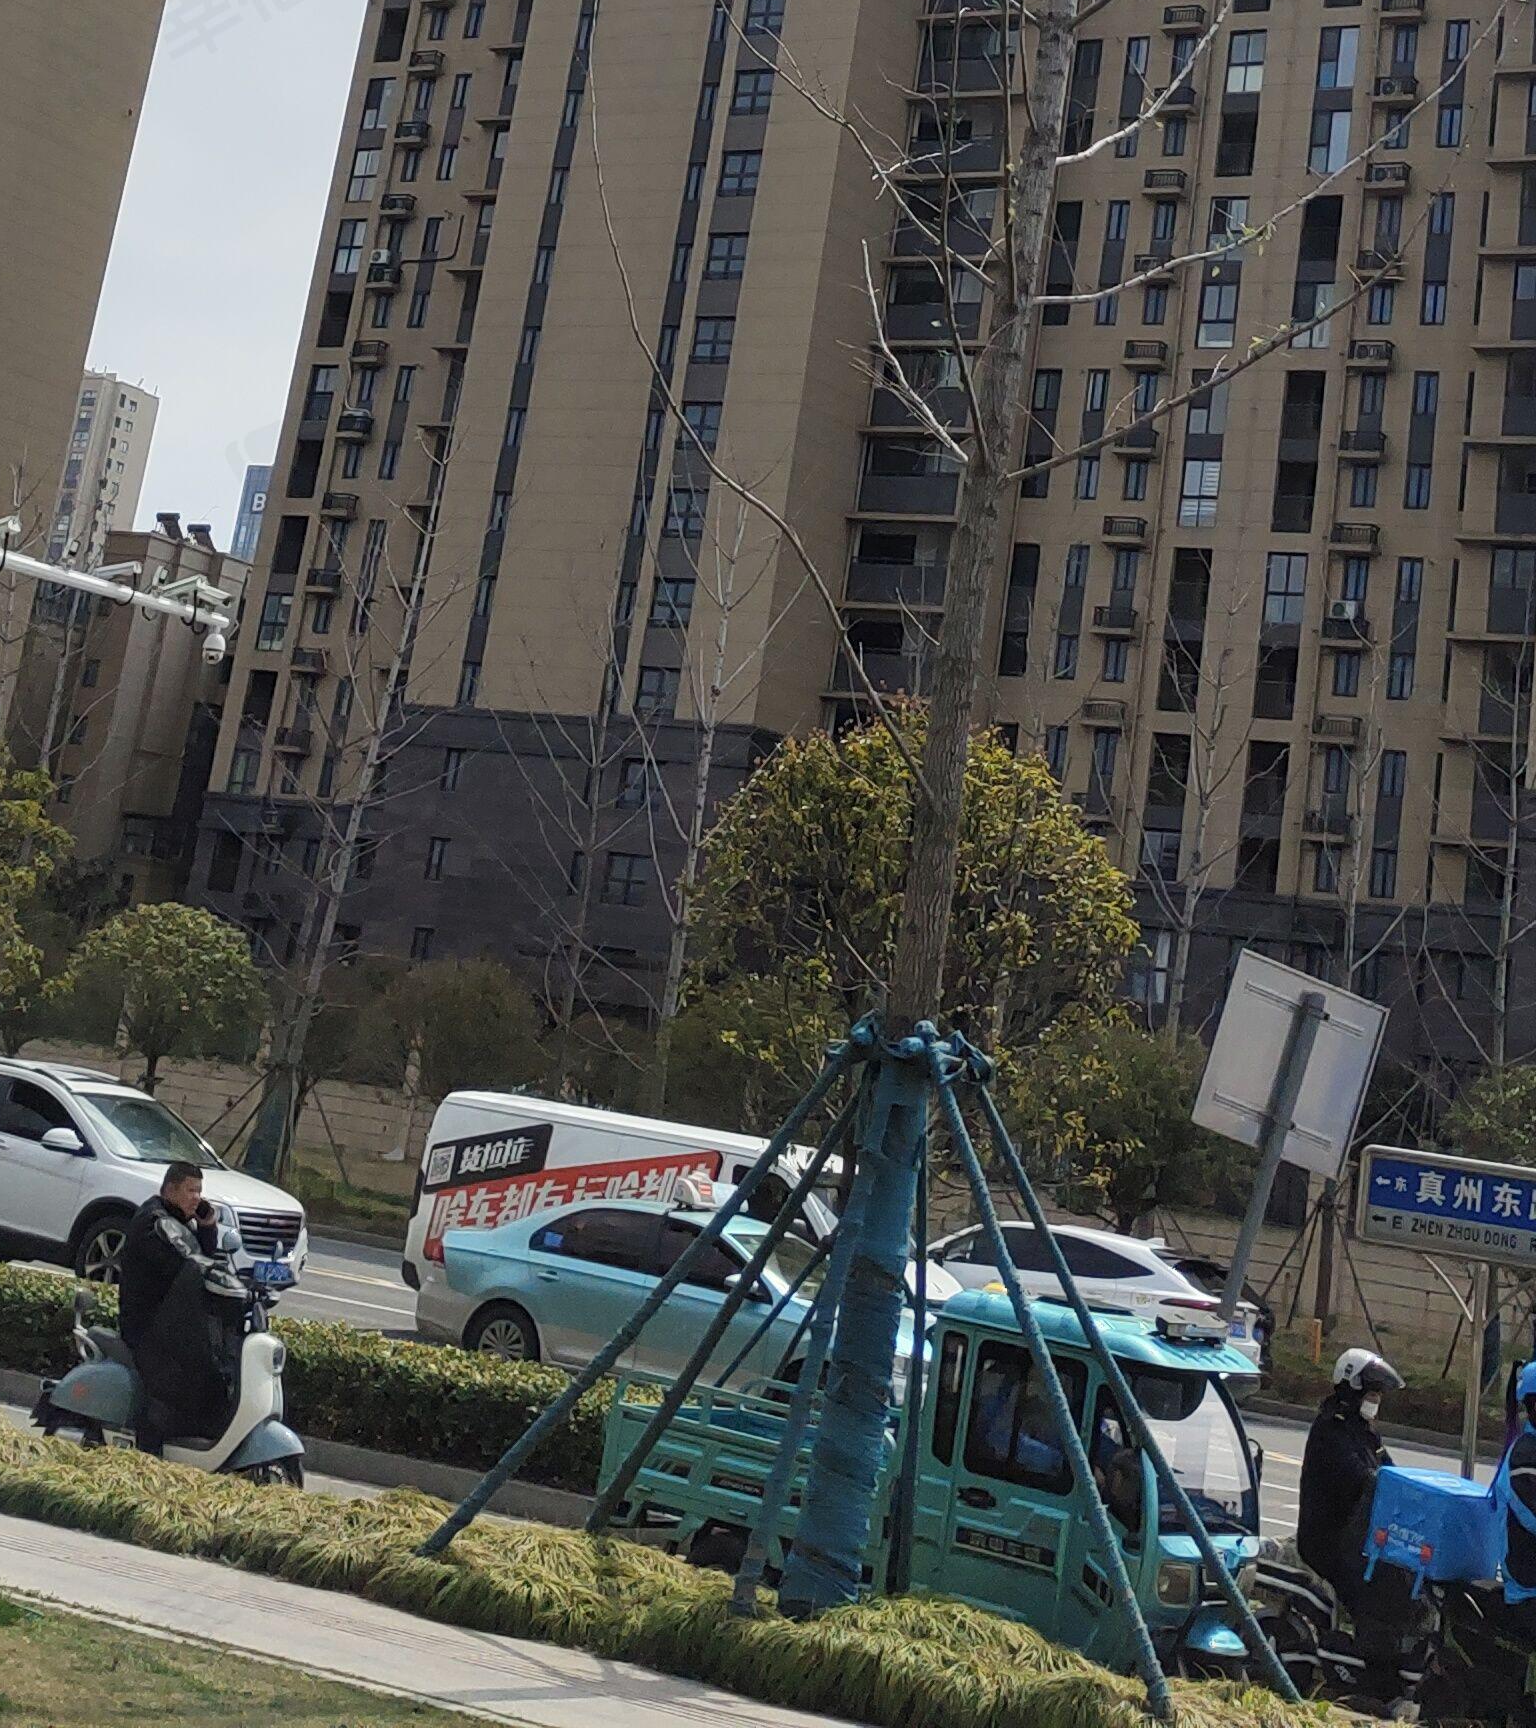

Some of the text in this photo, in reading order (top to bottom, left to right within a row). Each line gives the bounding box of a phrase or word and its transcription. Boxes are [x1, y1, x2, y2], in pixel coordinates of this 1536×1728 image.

[457, 1137, 536, 1175] 货拉拉
[1392, 1215, 1403, 1230] E
[1411, 1217, 1443, 1237] ZHEN
[1446, 1222, 1480, 1243] ZHOU
[1483, 1230, 1518, 1250] DONG
